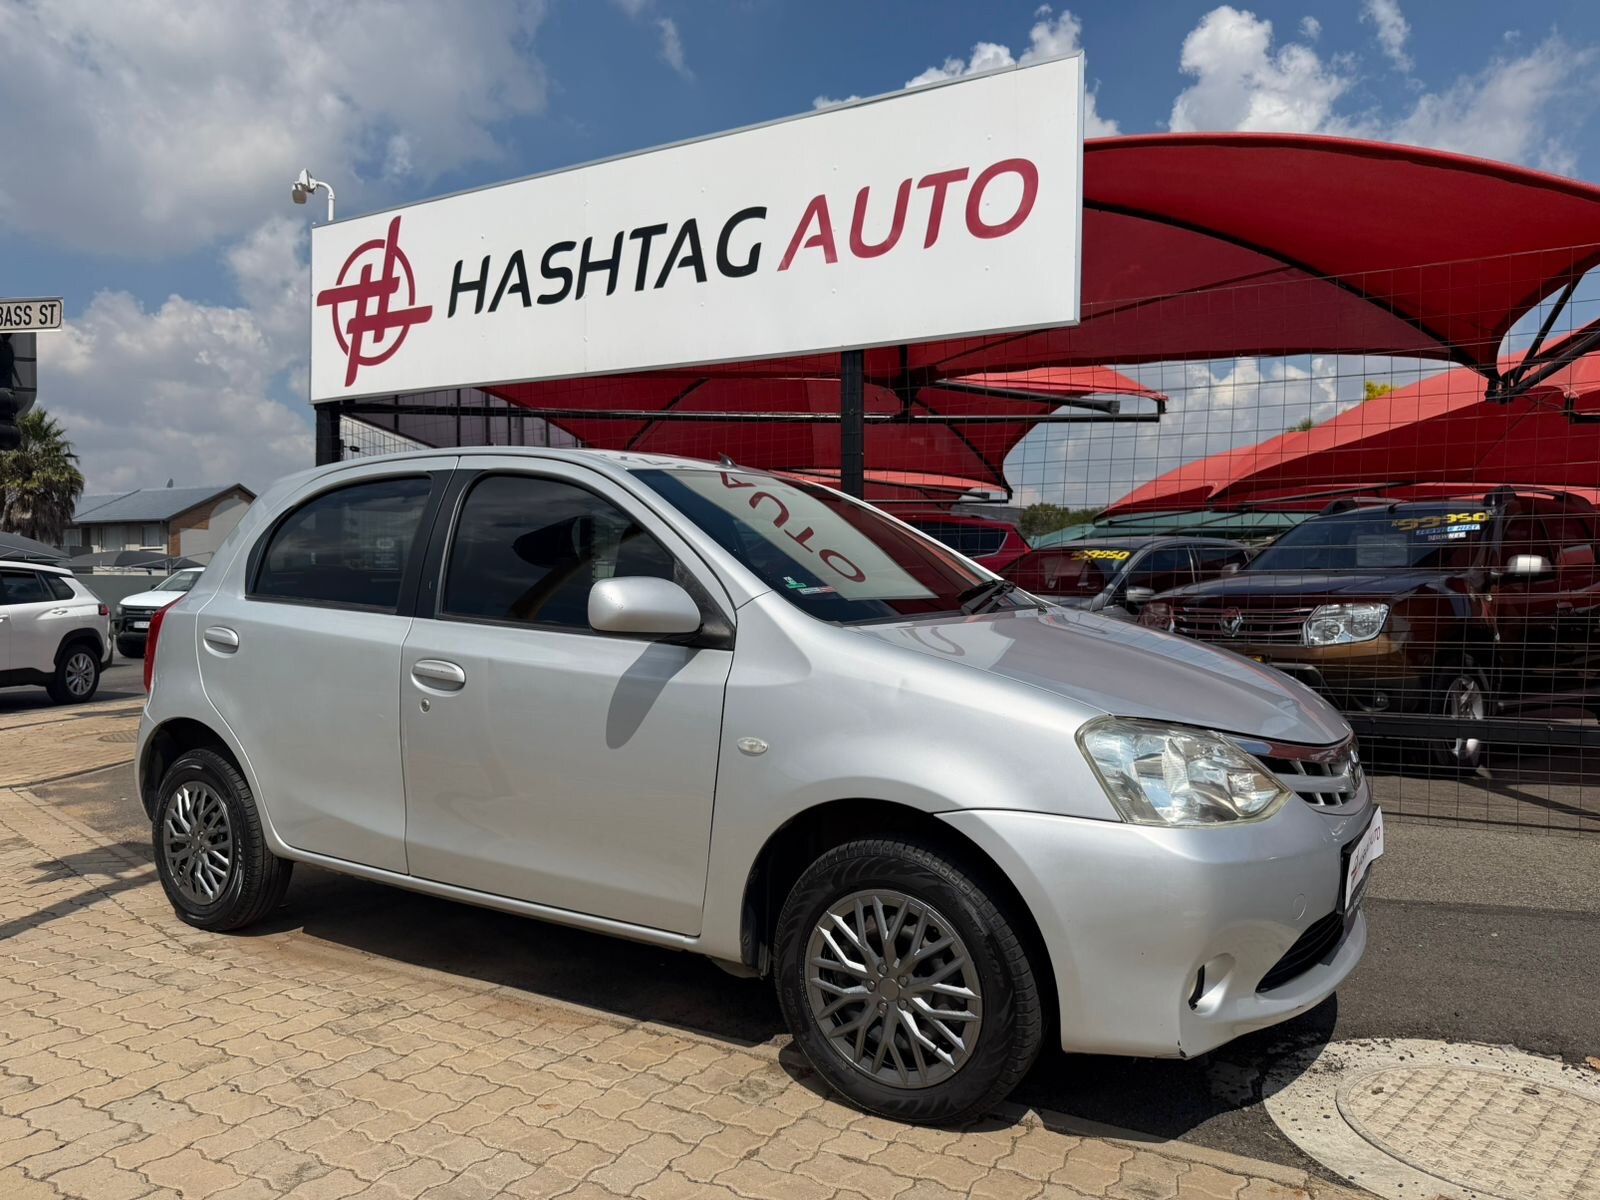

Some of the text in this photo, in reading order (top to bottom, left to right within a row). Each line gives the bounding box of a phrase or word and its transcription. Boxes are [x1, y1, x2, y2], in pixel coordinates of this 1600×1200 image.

[447, 158, 1039, 318] HASHTAG AUTO
[39, 304, 57, 325] ST
